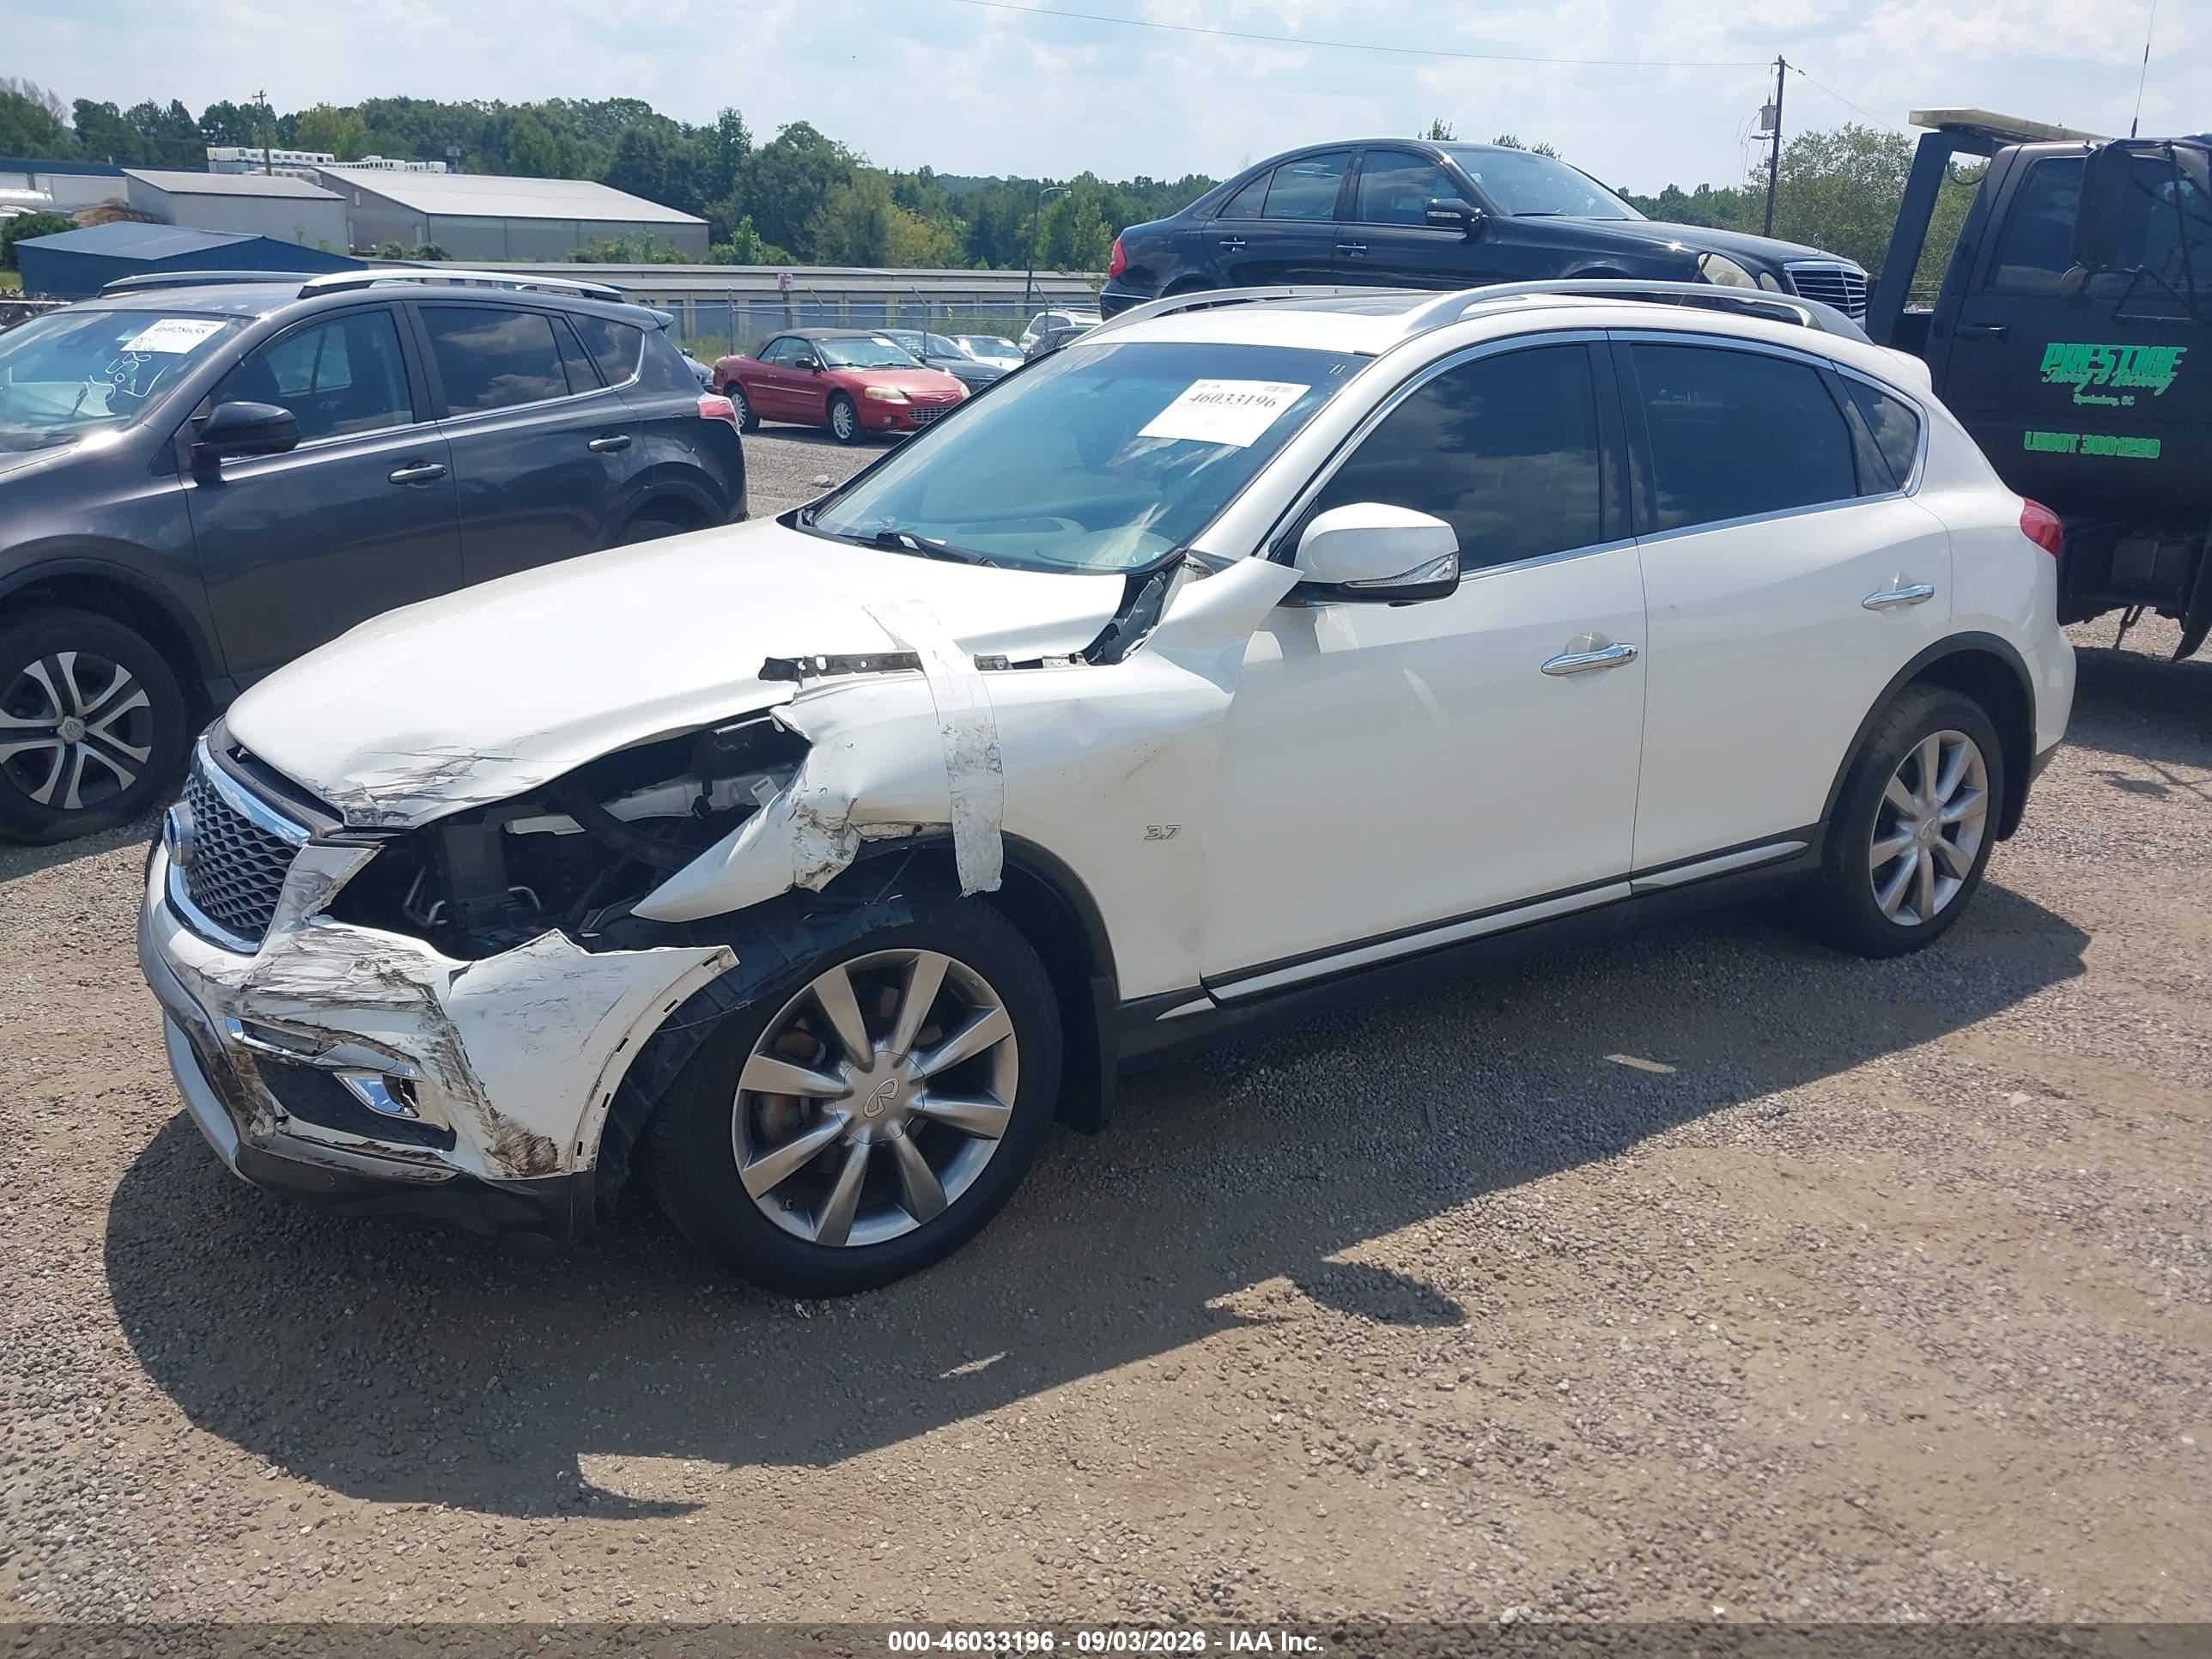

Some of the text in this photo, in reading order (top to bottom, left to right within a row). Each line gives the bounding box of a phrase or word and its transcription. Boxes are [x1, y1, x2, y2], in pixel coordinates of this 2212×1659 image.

[2039, 343, 2188, 375] PRESTIGE
[1188, 392, 1279, 409] 46033196
[1144, 824, 1182, 841] 3.7
